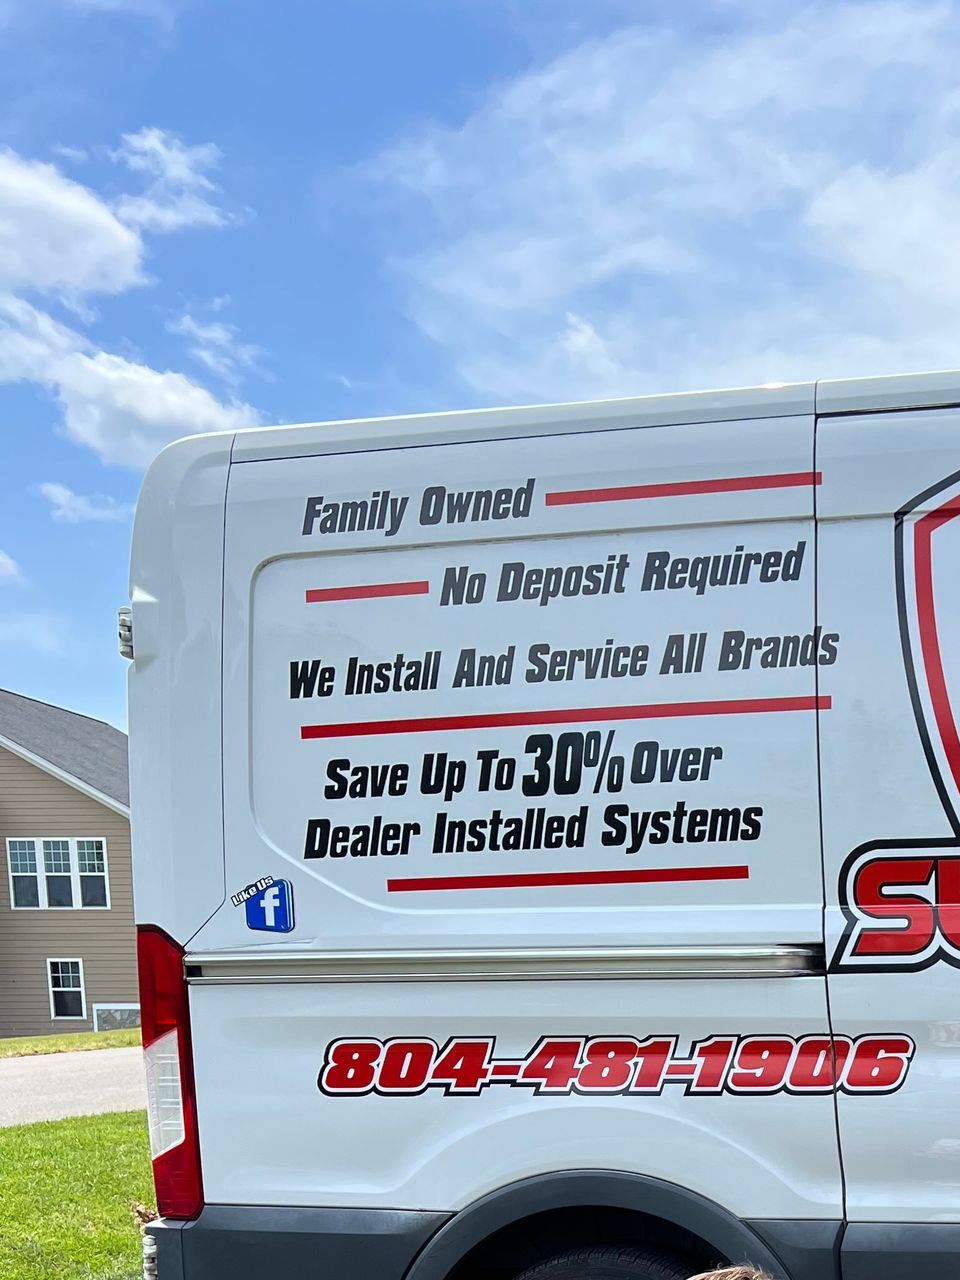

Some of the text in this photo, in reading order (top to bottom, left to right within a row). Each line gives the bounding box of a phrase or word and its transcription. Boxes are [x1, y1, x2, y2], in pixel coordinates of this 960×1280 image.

[302, 478, 535, 536] Family Owned
[439, 541, 807, 607] No Deposit Required
[288, 625, 841, 700] We Install And Service All Brands
[323, 729, 724, 802] Save Up To 30% Over
[302, 801, 764, 861] Dealer Installed Systems
[230, 875, 275, 908] Like Us
[320, 1034, 914, 1096] 804-481-1906
